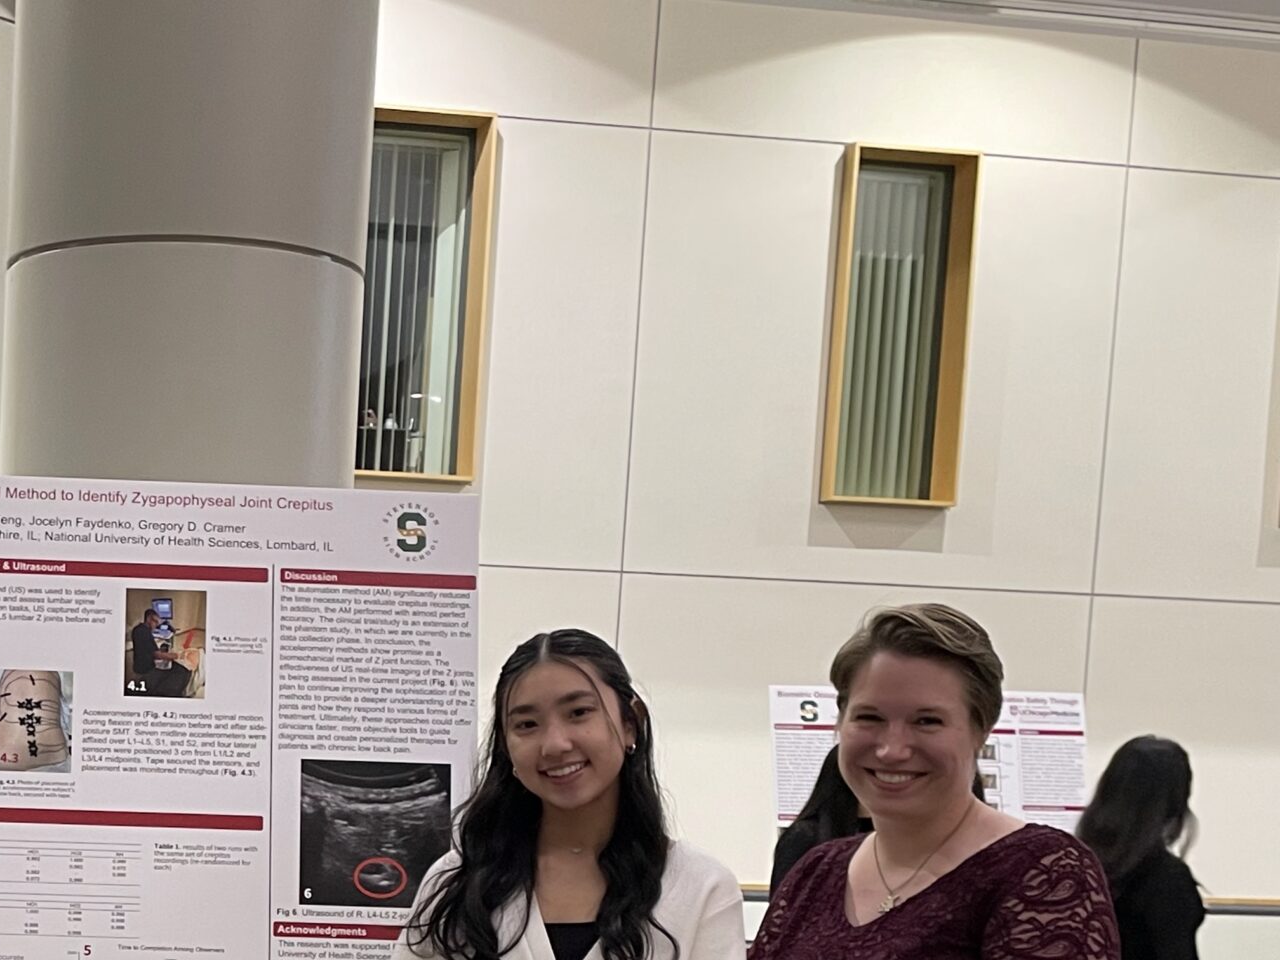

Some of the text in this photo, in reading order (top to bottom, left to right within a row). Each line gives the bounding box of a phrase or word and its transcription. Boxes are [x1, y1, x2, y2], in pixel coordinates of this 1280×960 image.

[5, 486, 56, 499] Method
[61, 488, 73, 500] to
[78, 489, 126, 505] Identify
[131, 491, 235, 508] Zygapophyseal
[239, 494, 271, 507] Joint
[276, 496, 333, 512] Crepitus
[382, 503, 440, 525] STEVENSON
[28, 515, 71, 528] Jocelyn
[75, 517, 134, 530] Faydenko,
[138, 519, 183, 532] Gregory
[203, 521, 246, 532] Cramer
[397, 512, 427, 552] S
[44, 531, 91, 541] National
[94, 532, 149, 546] University
[153, 534, 164, 544] of
[167, 535, 203, 545] Health
[207, 537, 264, 549] Sciences,
[266, 539, 320, 551] Lombard,
[323, 540, 333, 550] IL
[406, 540, 438, 562] SCHOOL
[2, 561, 10, 570] &
[12, 562, 66, 572] Ultrasound
[285, 571, 337, 581] Discussion
[127, 681, 146, 691] 4.1
[0, 753, 19, 763] 4.3
[304, 889, 312, 898] 6
[292, 907, 297, 915] 6
[277, 924, 367, 937] Acknowledgments
[84, 945, 91, 956] 5
